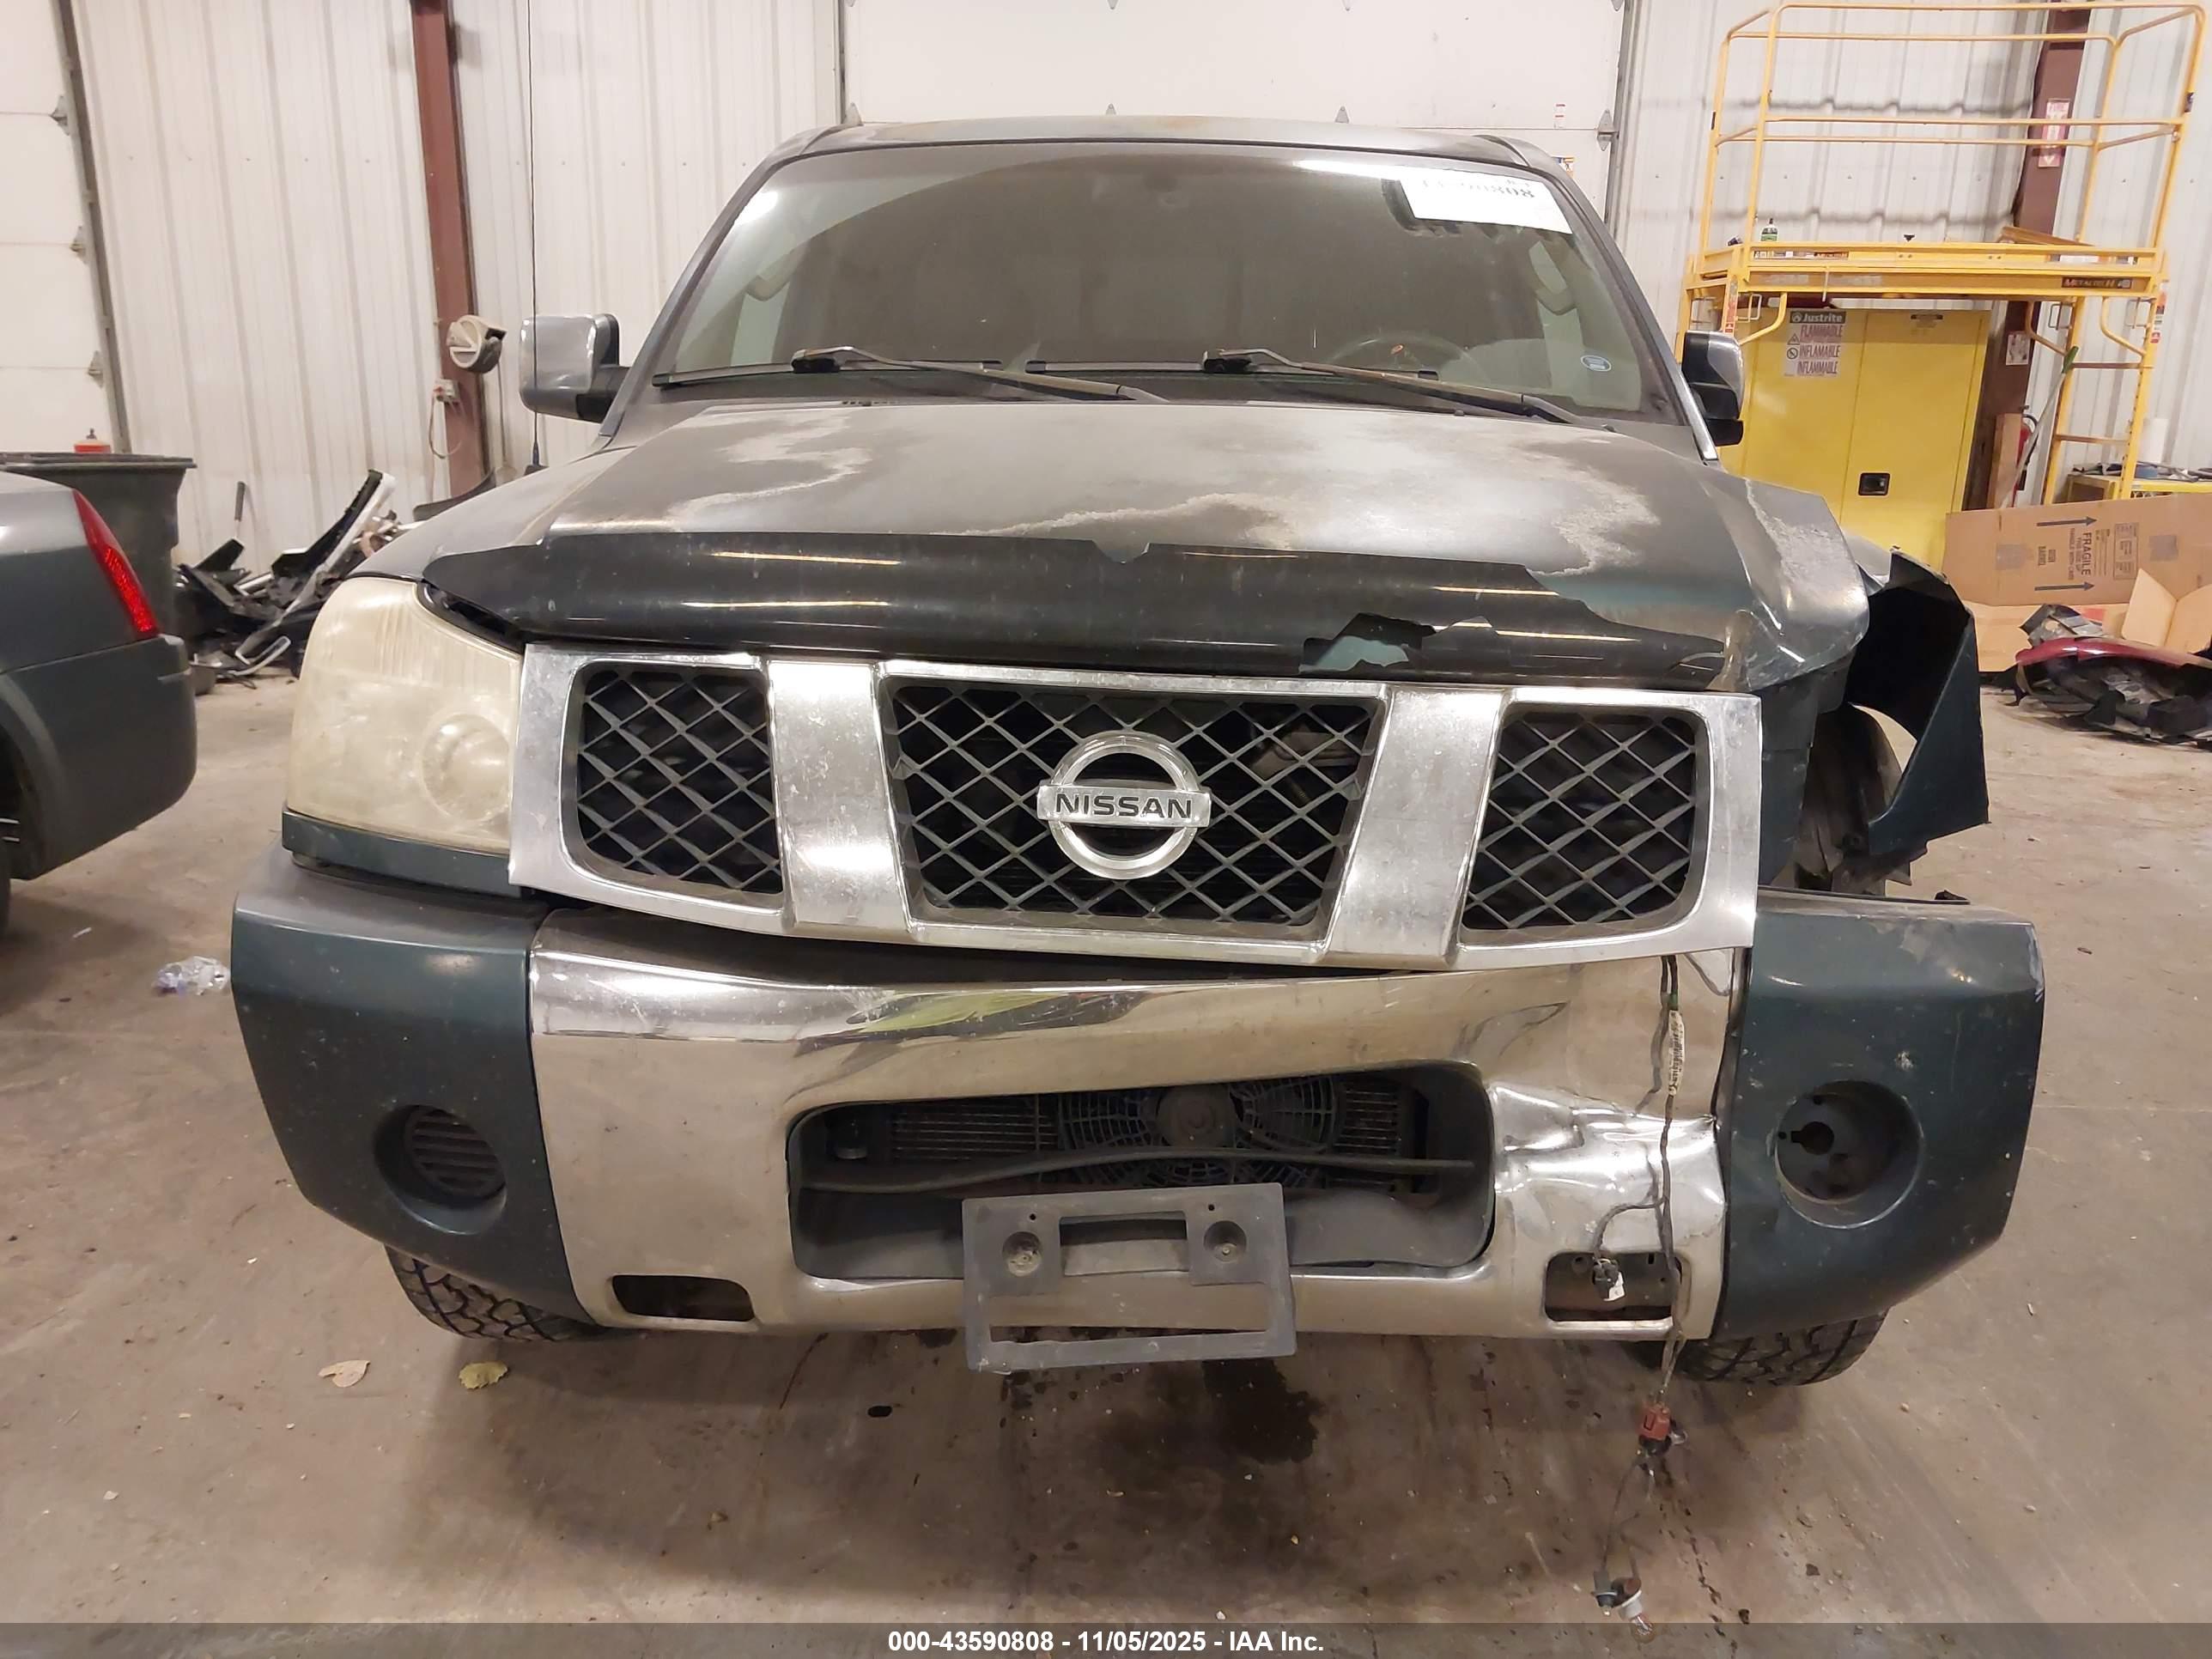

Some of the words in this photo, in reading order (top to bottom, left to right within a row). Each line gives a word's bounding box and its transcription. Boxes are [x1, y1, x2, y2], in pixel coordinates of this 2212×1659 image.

[1802, 313, 1843, 322] Justrite
[2081, 532, 2093, 575] FRAGILE
[1055, 793, 1193, 819] NISSAN
